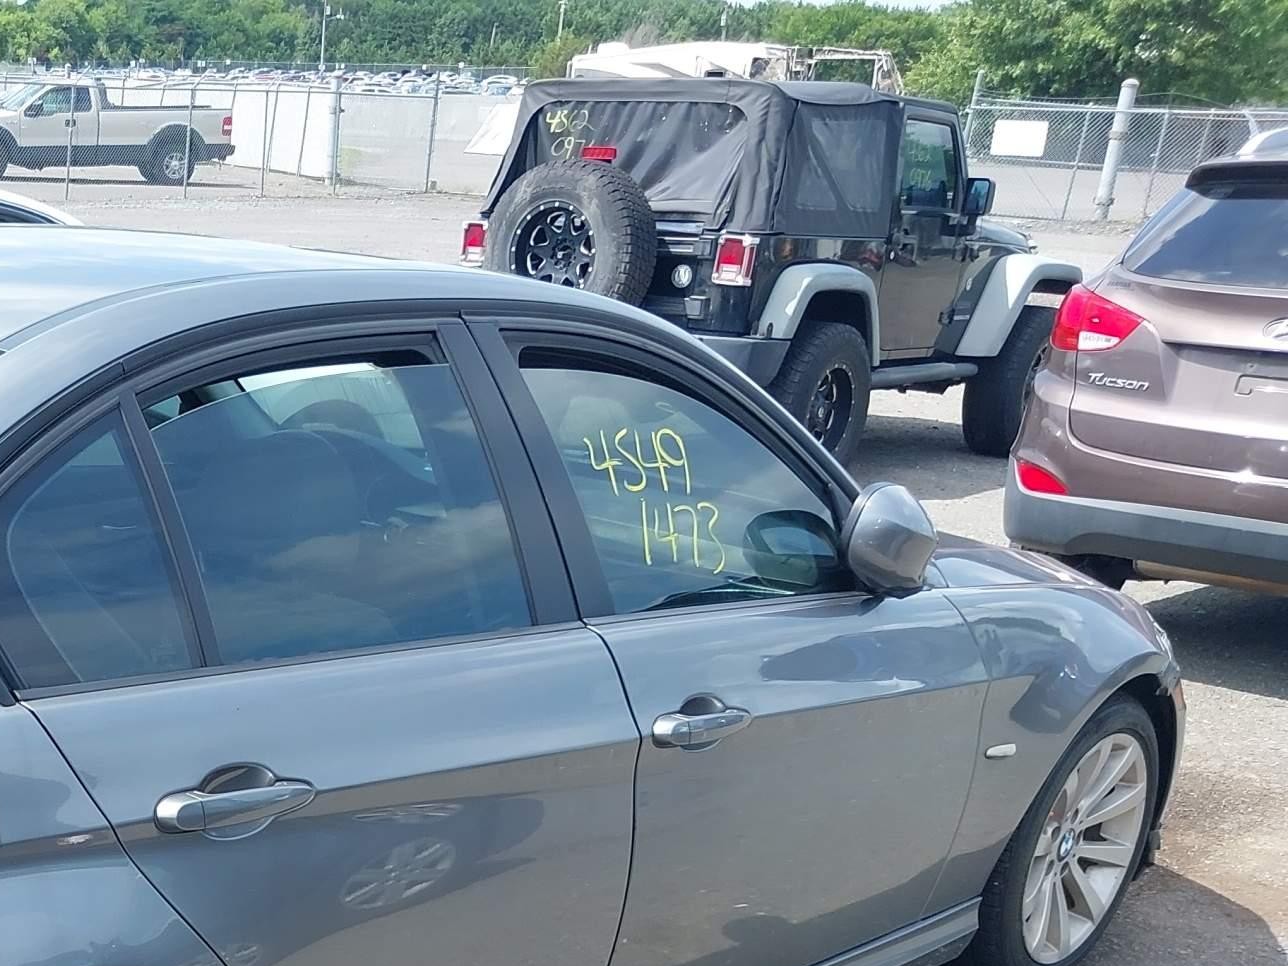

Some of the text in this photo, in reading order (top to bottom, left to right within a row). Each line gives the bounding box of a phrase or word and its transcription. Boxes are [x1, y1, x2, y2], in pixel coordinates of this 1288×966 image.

[546, 109, 597, 133] 4562
[1088, 372, 1149, 391] Tucson
[583, 428, 691, 496] 4549
[640, 497, 726, 574] 1473
